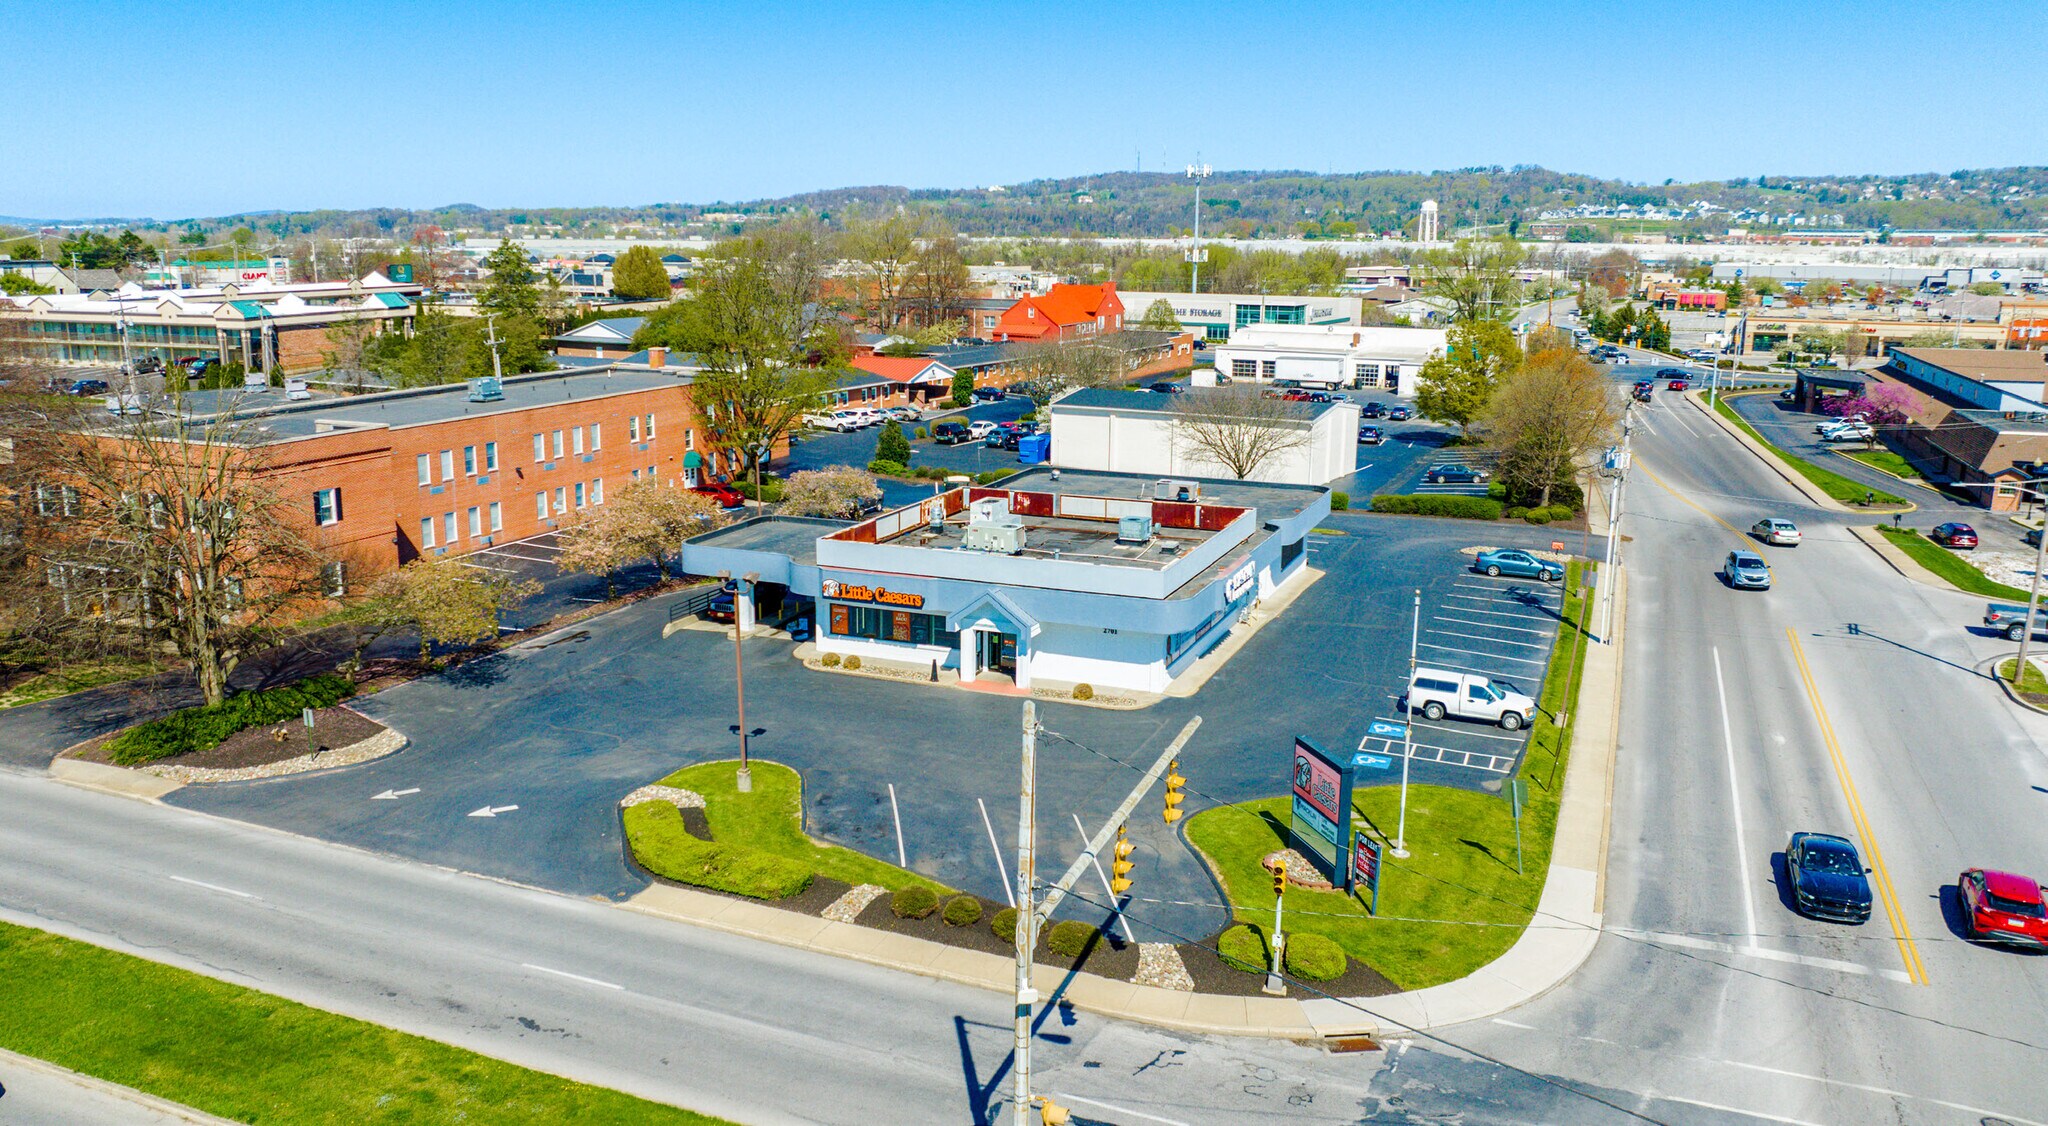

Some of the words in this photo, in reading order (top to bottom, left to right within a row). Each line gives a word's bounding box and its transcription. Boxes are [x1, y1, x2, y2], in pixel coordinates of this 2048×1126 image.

[1189, 308, 1222, 318] STORAGE
[1756, 322, 1787, 331] cricket
[840, 583, 873, 601] Little
[874, 586, 923, 607] Caesars
[1317, 773, 1336, 800] Little
[1311, 783, 1338, 815] Caesars
[1359, 833, 1368, 846] FOR
